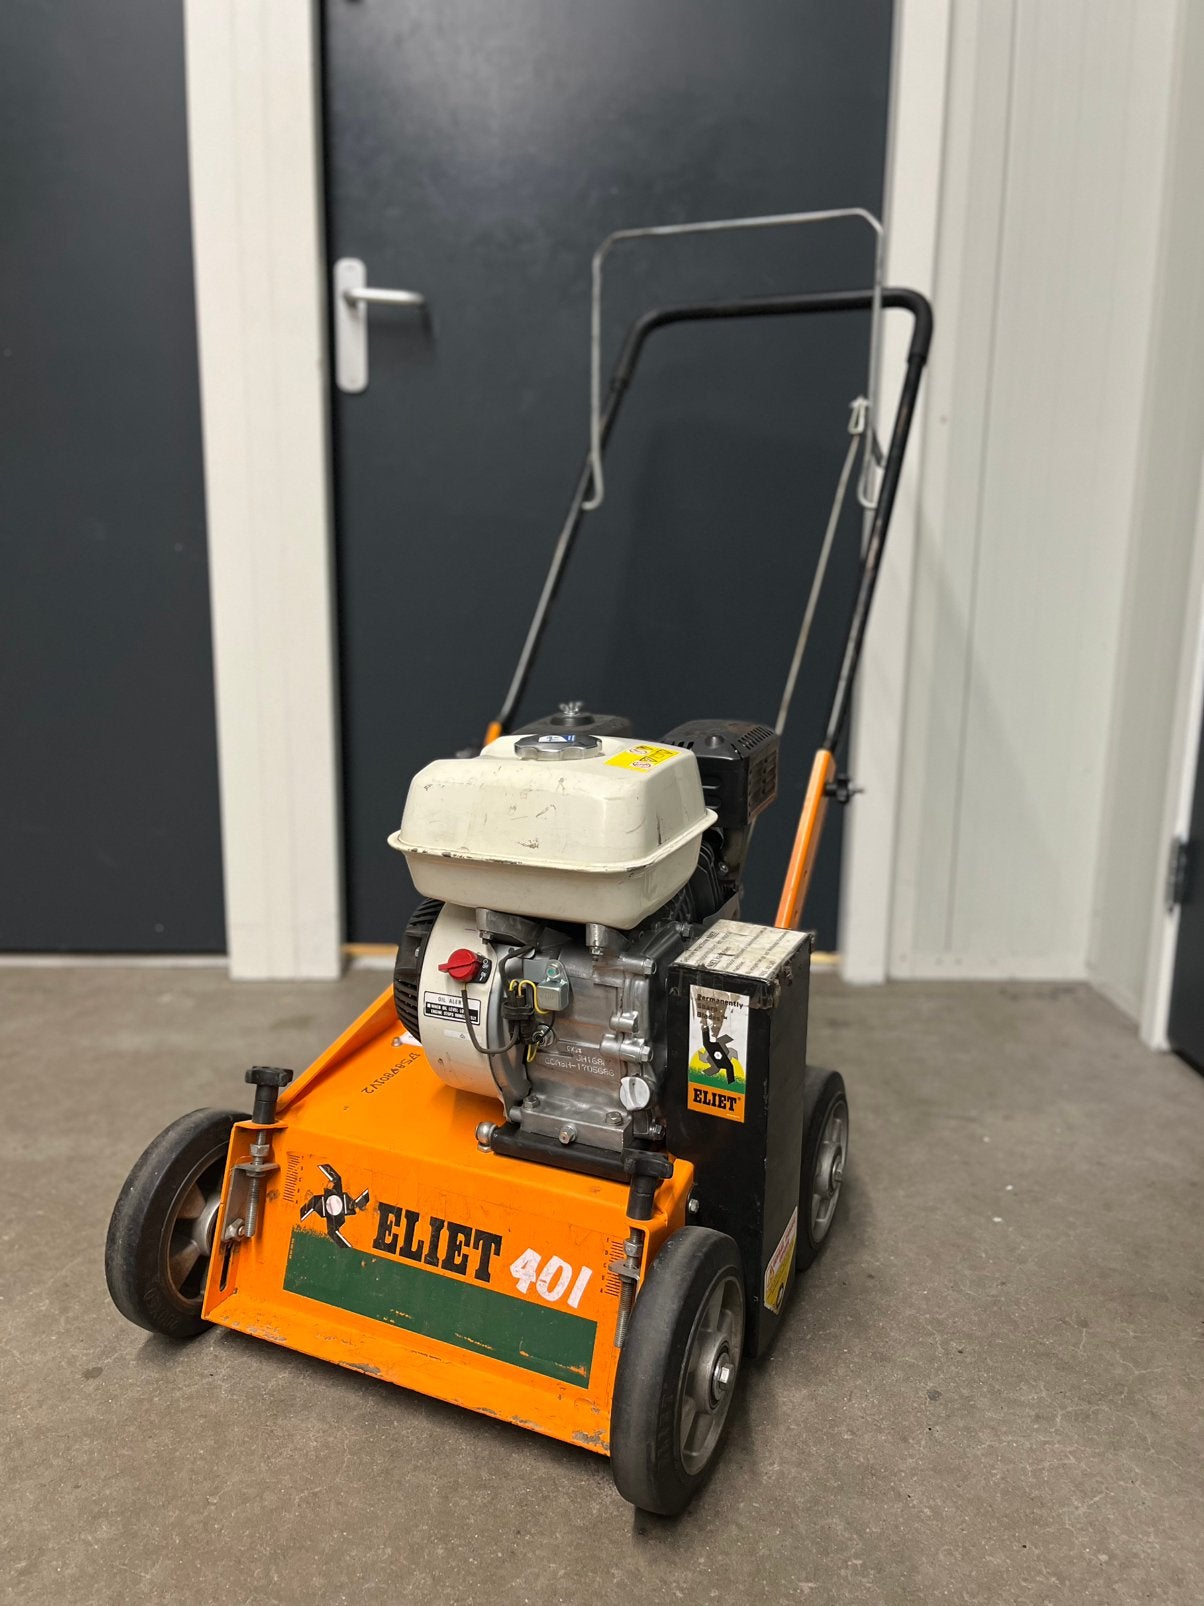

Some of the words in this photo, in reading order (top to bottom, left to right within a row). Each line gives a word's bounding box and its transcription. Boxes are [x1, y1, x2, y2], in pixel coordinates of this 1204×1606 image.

[697, 993, 744, 1010] Permanently
[693, 1087, 737, 1112] ELIET
[372, 1201, 503, 1283] ELIET
[509, 1247, 593, 1310] 401
